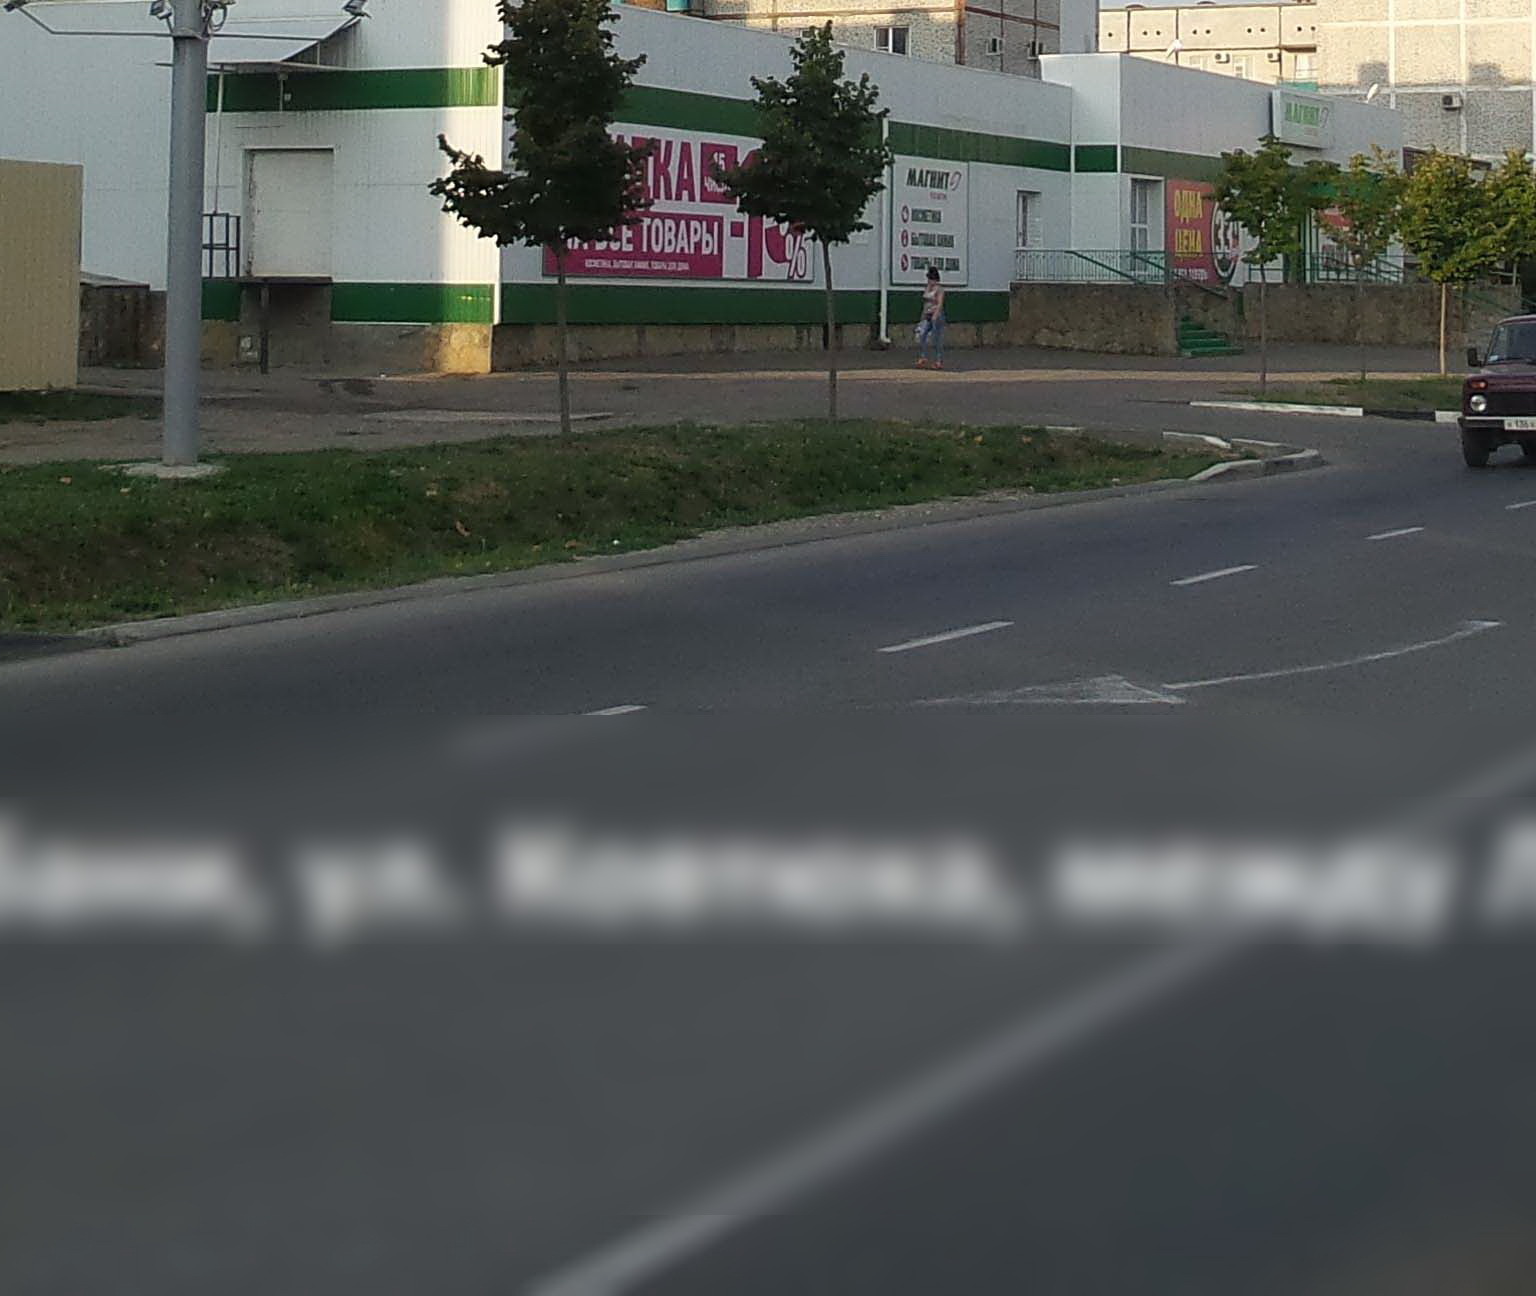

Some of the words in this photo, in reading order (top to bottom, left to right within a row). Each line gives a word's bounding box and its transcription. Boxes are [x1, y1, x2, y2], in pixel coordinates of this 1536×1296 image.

[906, 168, 950, 190] МАГНИТ
[1175, 190, 1203, 223] ОДНА
[641, 217, 718, 255] ТОВАРЫ
[1175, 229, 1203, 262] ЦЕНА
